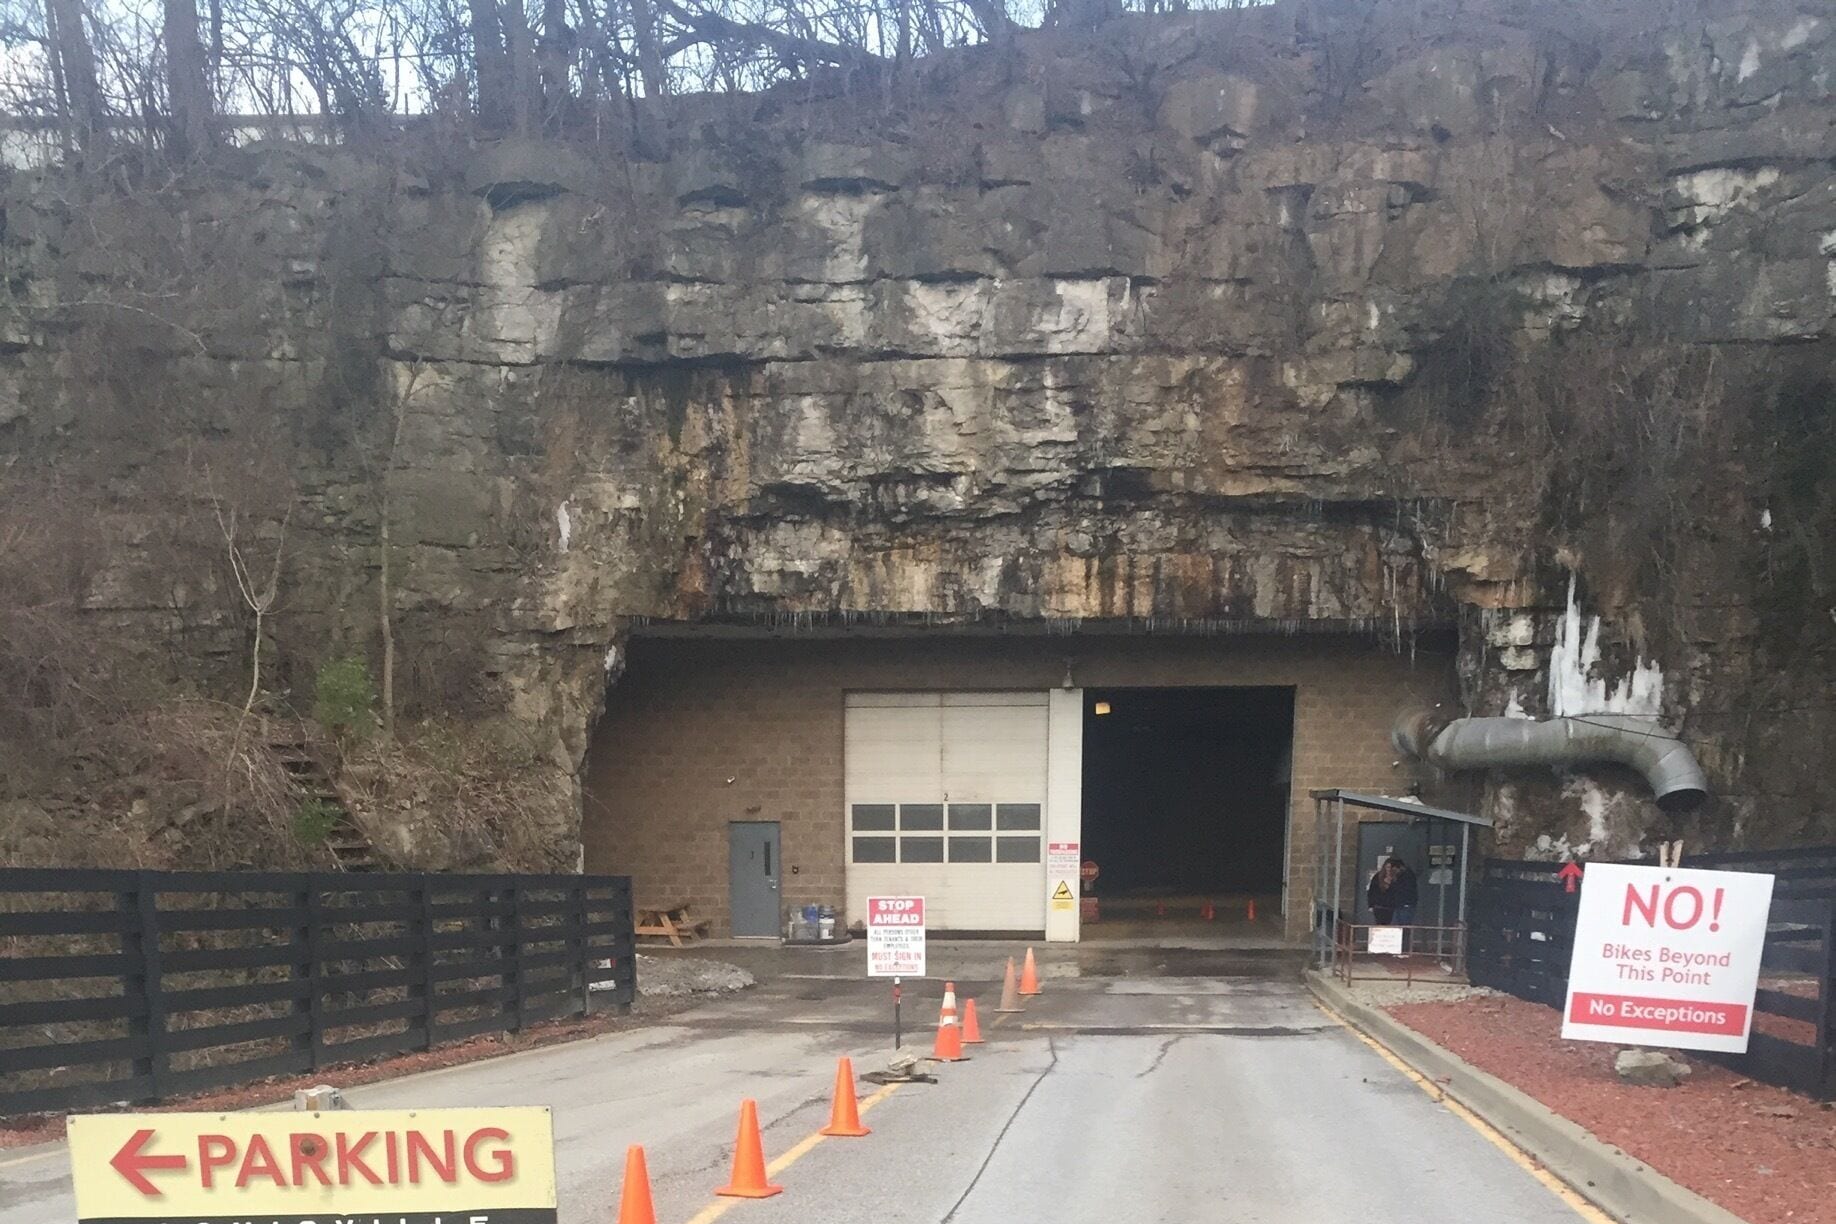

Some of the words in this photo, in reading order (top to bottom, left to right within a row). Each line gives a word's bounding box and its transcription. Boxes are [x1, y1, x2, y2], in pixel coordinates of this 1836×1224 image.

[878, 900, 914, 911] STOP
[1622, 883, 1724, 932] NO!
[873, 913, 919, 924] AHEAD
[871, 952, 891, 961] MUST
[894, 952, 911, 961] SIGN
[914, 952, 922, 961] IN
[1602, 944, 1652, 961] Bikes
[1659, 948, 1731, 968] Beyond
[1616, 964, 1654, 981] This
[1662, 967, 1711, 985] Point
[1590, 999, 1614, 1016] No
[1621, 1002, 1726, 1025] Exceptions
[198, 1127, 514, 1188] PARKING
